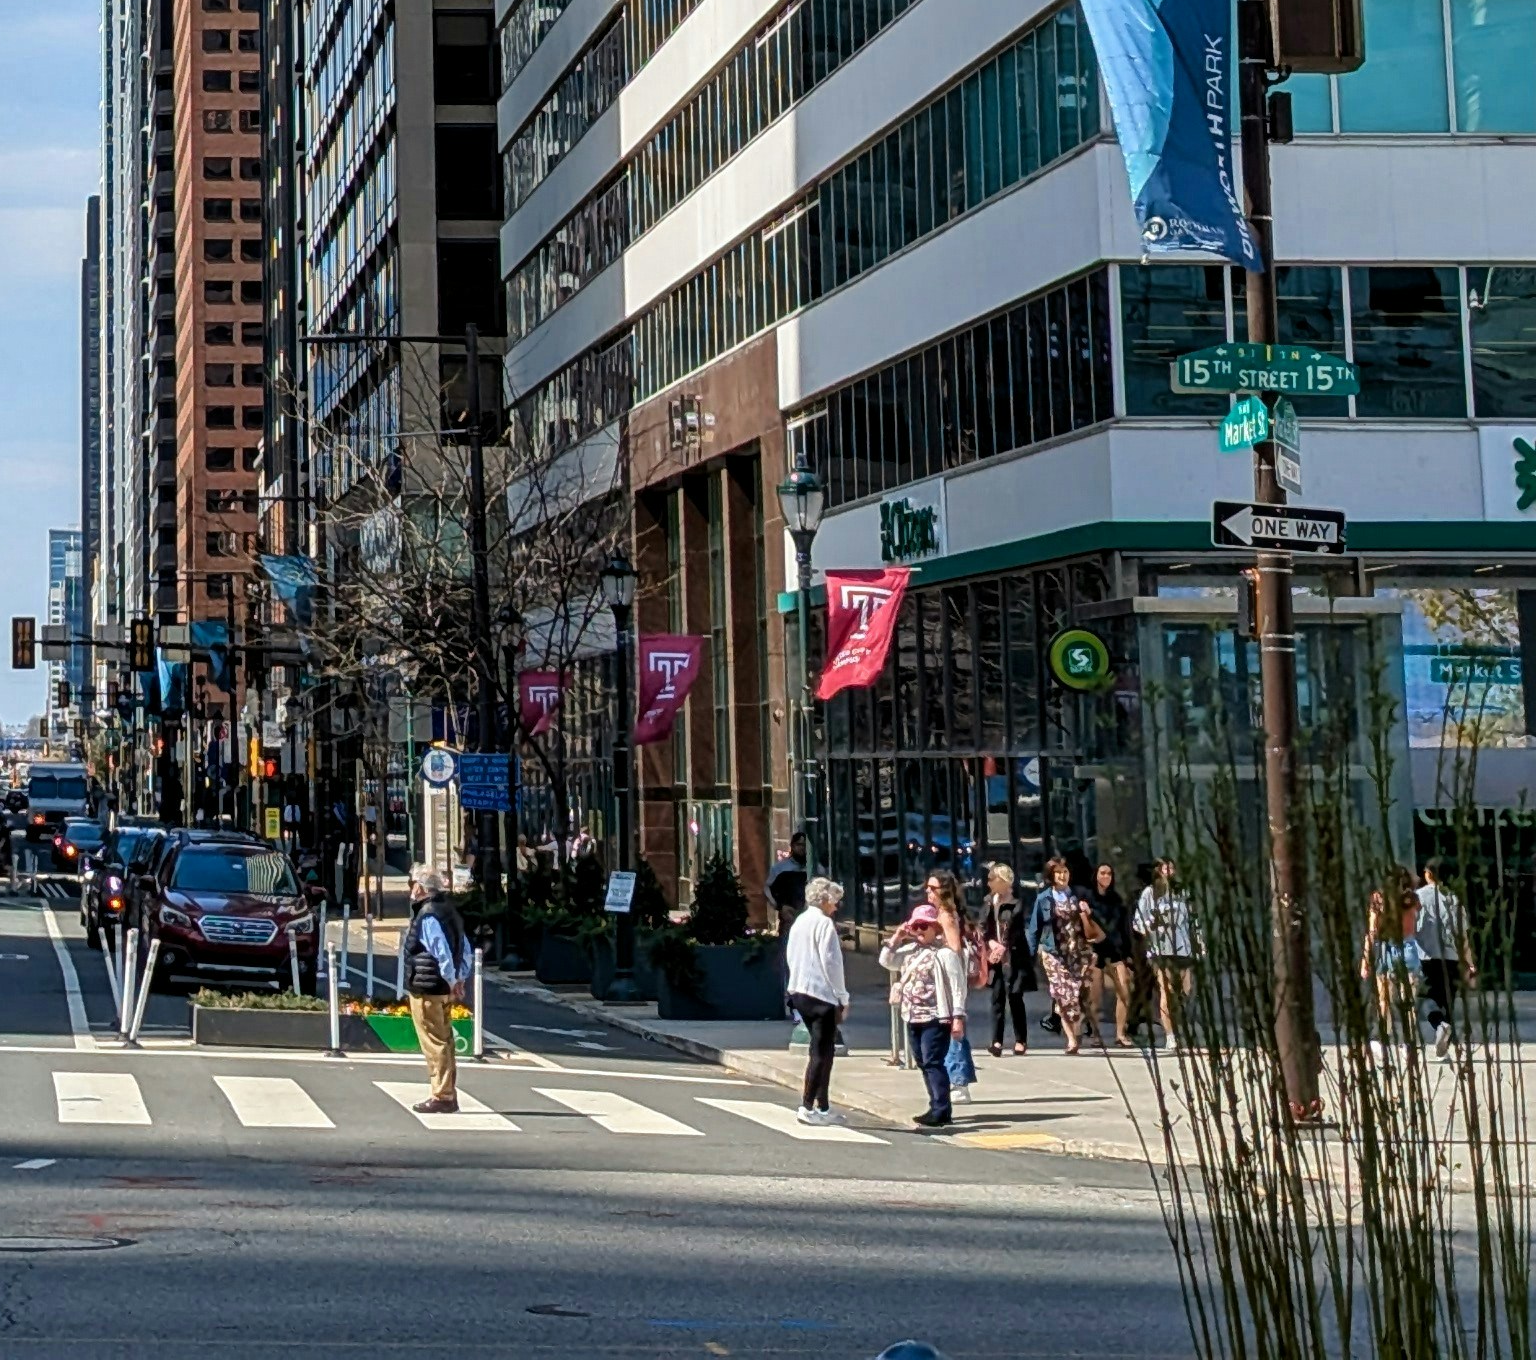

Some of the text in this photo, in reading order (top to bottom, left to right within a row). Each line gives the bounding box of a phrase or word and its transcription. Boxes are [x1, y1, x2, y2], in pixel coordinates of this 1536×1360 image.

[1204, 34, 1224, 110] PARK
[1183, 358, 1355, 391] 15TH STREET 15TH
[1224, 412, 1257, 448] Market
[1251, 517, 1331, 540] ONE WAY
